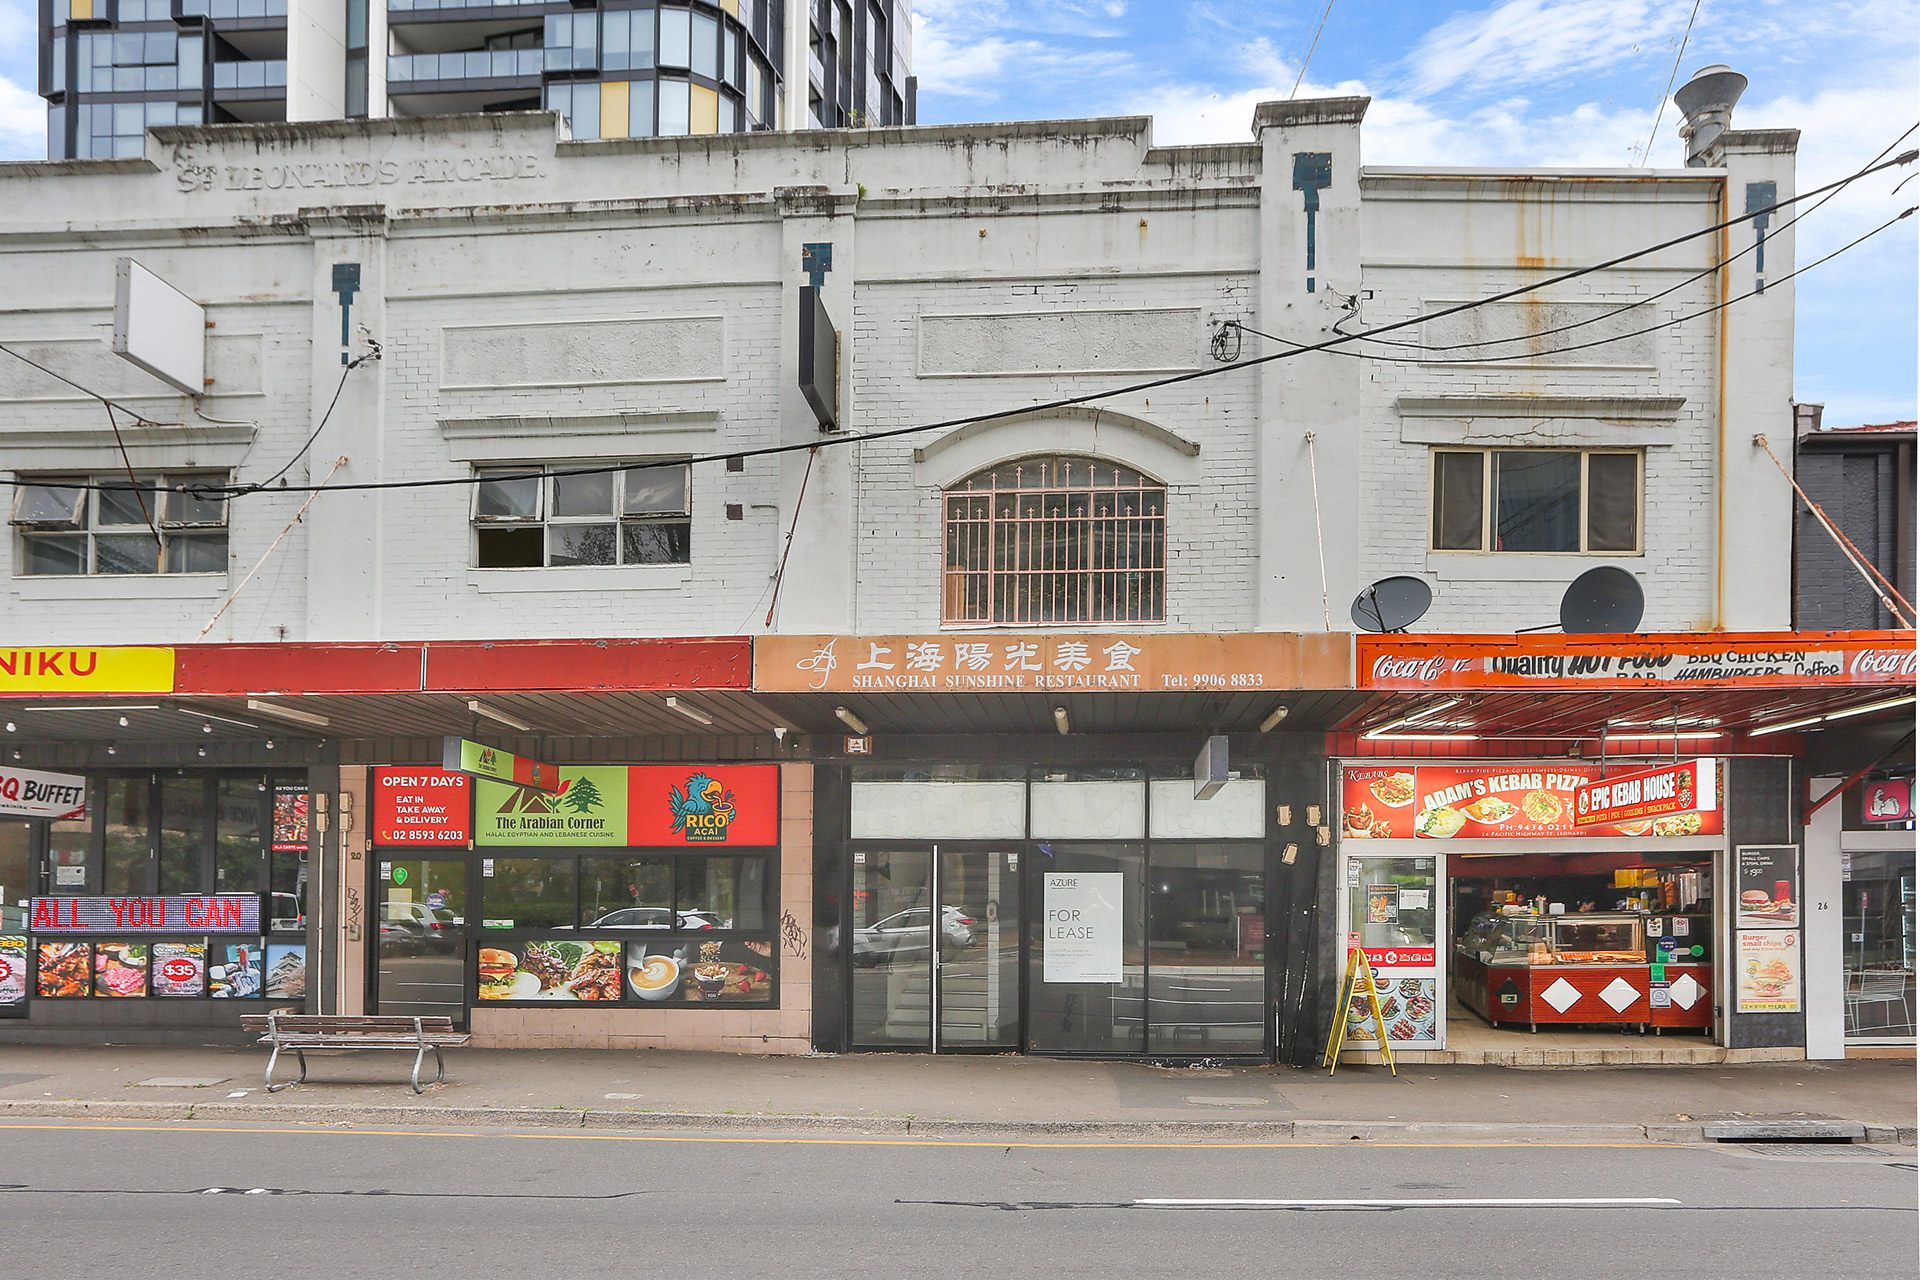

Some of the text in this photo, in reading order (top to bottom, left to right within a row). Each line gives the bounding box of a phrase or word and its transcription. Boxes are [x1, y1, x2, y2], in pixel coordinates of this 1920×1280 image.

[857, 641, 1142, 671] 上海陽光美食
[1795, 661, 1840, 676] Coffee
[852, 673, 1264, 688] SHANGHAI SUNSHINE RESTAURANT Tel: 9906 8833
[382, 776, 464, 787] OPEN 7 DAYS
[1348, 770, 1388, 781] KEBABS
[22, 780, 83, 805] BUFFET
[1424, 781, 1485, 811] ADAM'S
[1488, 774, 1542, 792] KEBAB
[1592, 772, 1675, 811] EPIC KEBAB HOUSE
[496, 817, 605, 829] The Arabian Corner
[686, 815, 726, 827] RICO
[393, 830, 463, 840] 02 8593 6203
[33, 898, 241, 928] ALL YOU CAN
[1049, 910, 1080, 922] FOR
[1049, 927, 1094, 939] LEASE
[165, 964, 194, 976] $35
